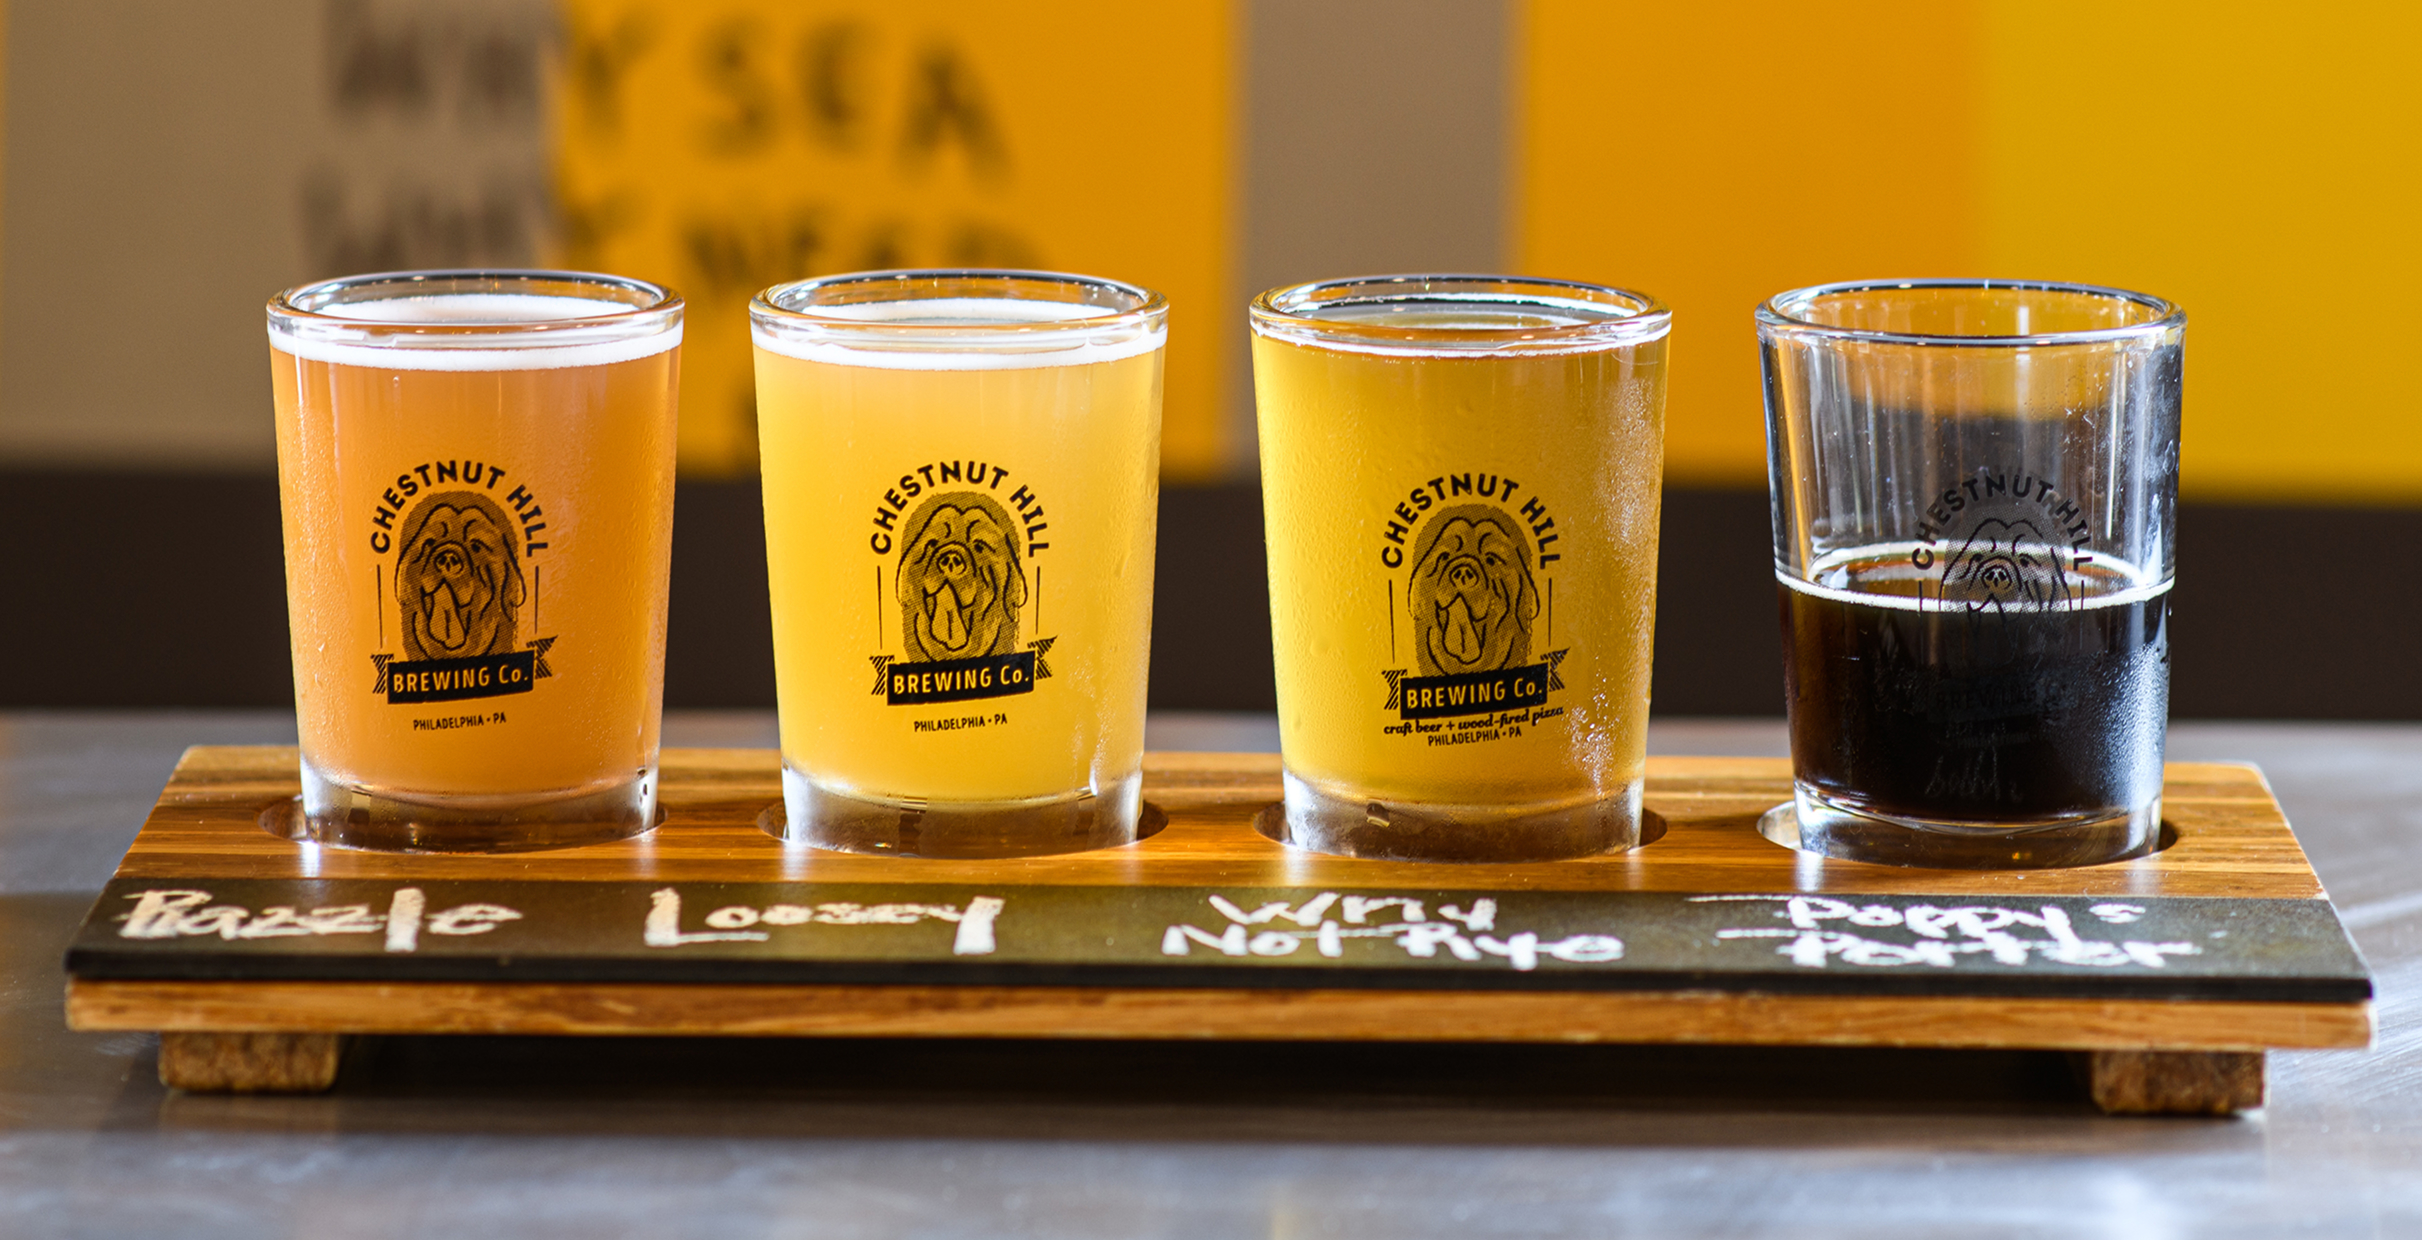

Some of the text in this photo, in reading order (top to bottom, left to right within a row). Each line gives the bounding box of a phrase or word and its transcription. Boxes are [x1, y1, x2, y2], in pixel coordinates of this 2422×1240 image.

[370, 460, 549, 558] CHESTNUT HILL
[870, 460, 1050, 558] CHESTNUT HILL
[1381, 473, 1561, 570] CHESTNUT HILL
[1911, 473, 2093, 571] CHESTNUT HILL
[393, 664, 528, 693] BREWING Co.
[893, 665, 1029, 694] BREWING Co.
[1406, 678, 1543, 709] BREWING Co.
[413, 712, 507, 731] PHILADELPHIA PA
[914, 713, 1008, 732] PHILADELPHIA PA
[1383, 719, 1413, 737] craft
[1415, 718, 1442, 733] beer
[1458, 708, 1530, 731] wood-fired
[1532, 706, 1564, 726] pizza
[1428, 725, 1522, 746] PHILADELPHIA PA
[114, 887, 523, 953] Razzle
[644, 887, 1006, 955] Loosey
